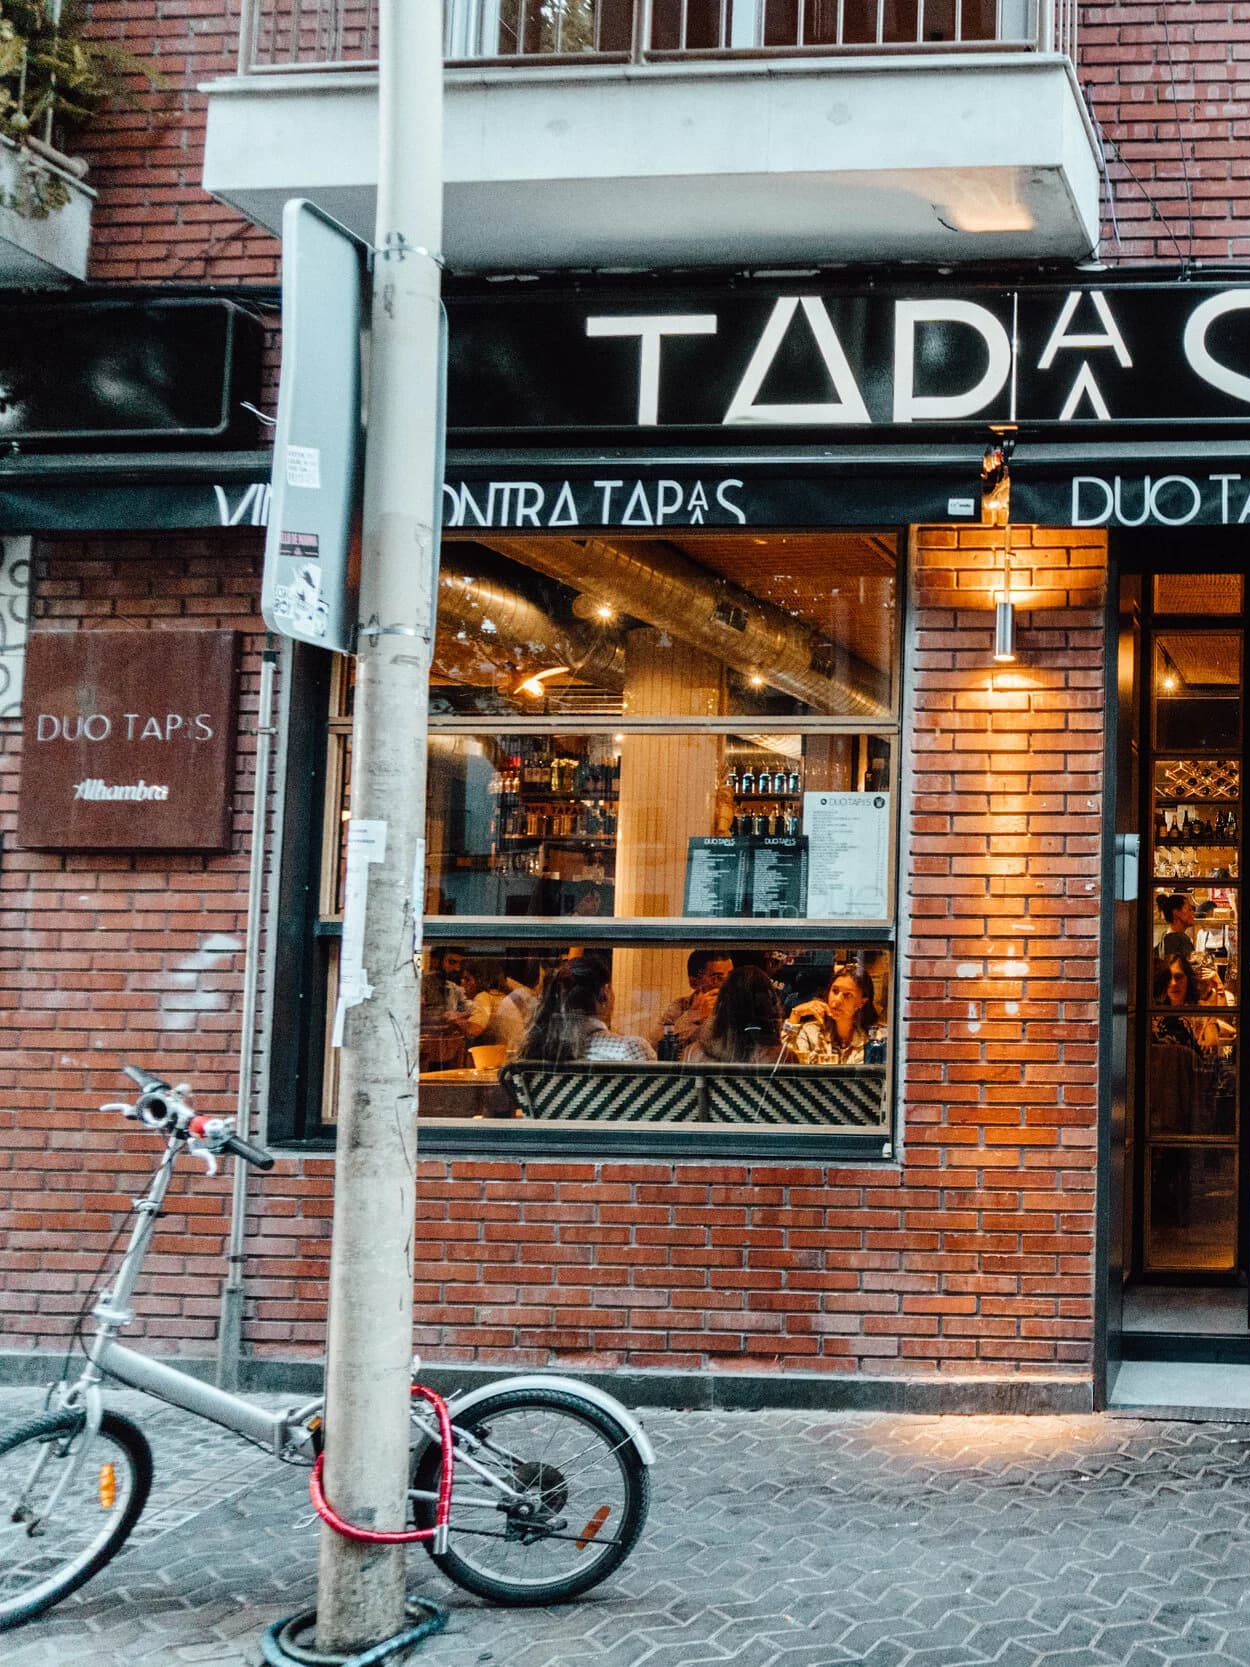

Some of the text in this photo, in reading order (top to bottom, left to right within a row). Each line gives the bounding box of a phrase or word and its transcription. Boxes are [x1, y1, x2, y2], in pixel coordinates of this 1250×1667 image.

[1071, 475, 1200, 527] DUO
[36, 714, 111, 742] DUO
[73, 779, 169, 801] Alhambra
